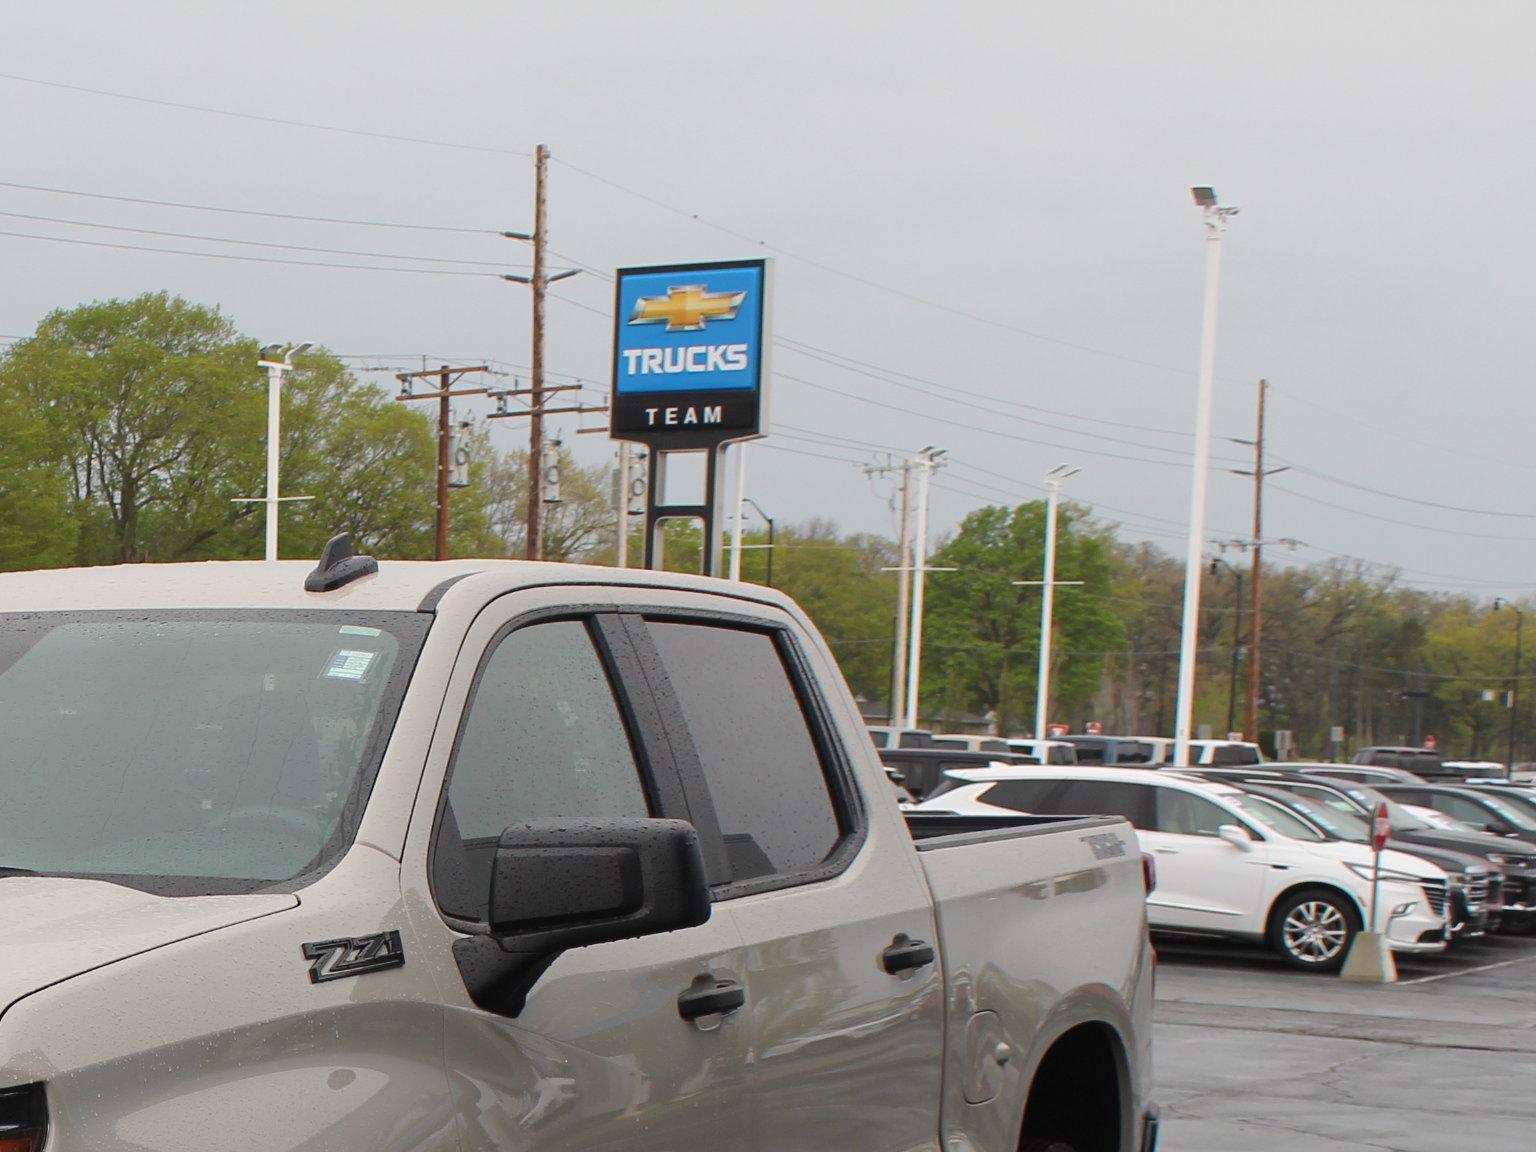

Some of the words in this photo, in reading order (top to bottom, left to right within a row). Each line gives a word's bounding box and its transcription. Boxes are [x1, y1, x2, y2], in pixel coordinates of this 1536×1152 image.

[622, 344, 749, 375] TRUCKS
[645, 406, 722, 425] TEAM
[302, 929, 405, 984] Z71
